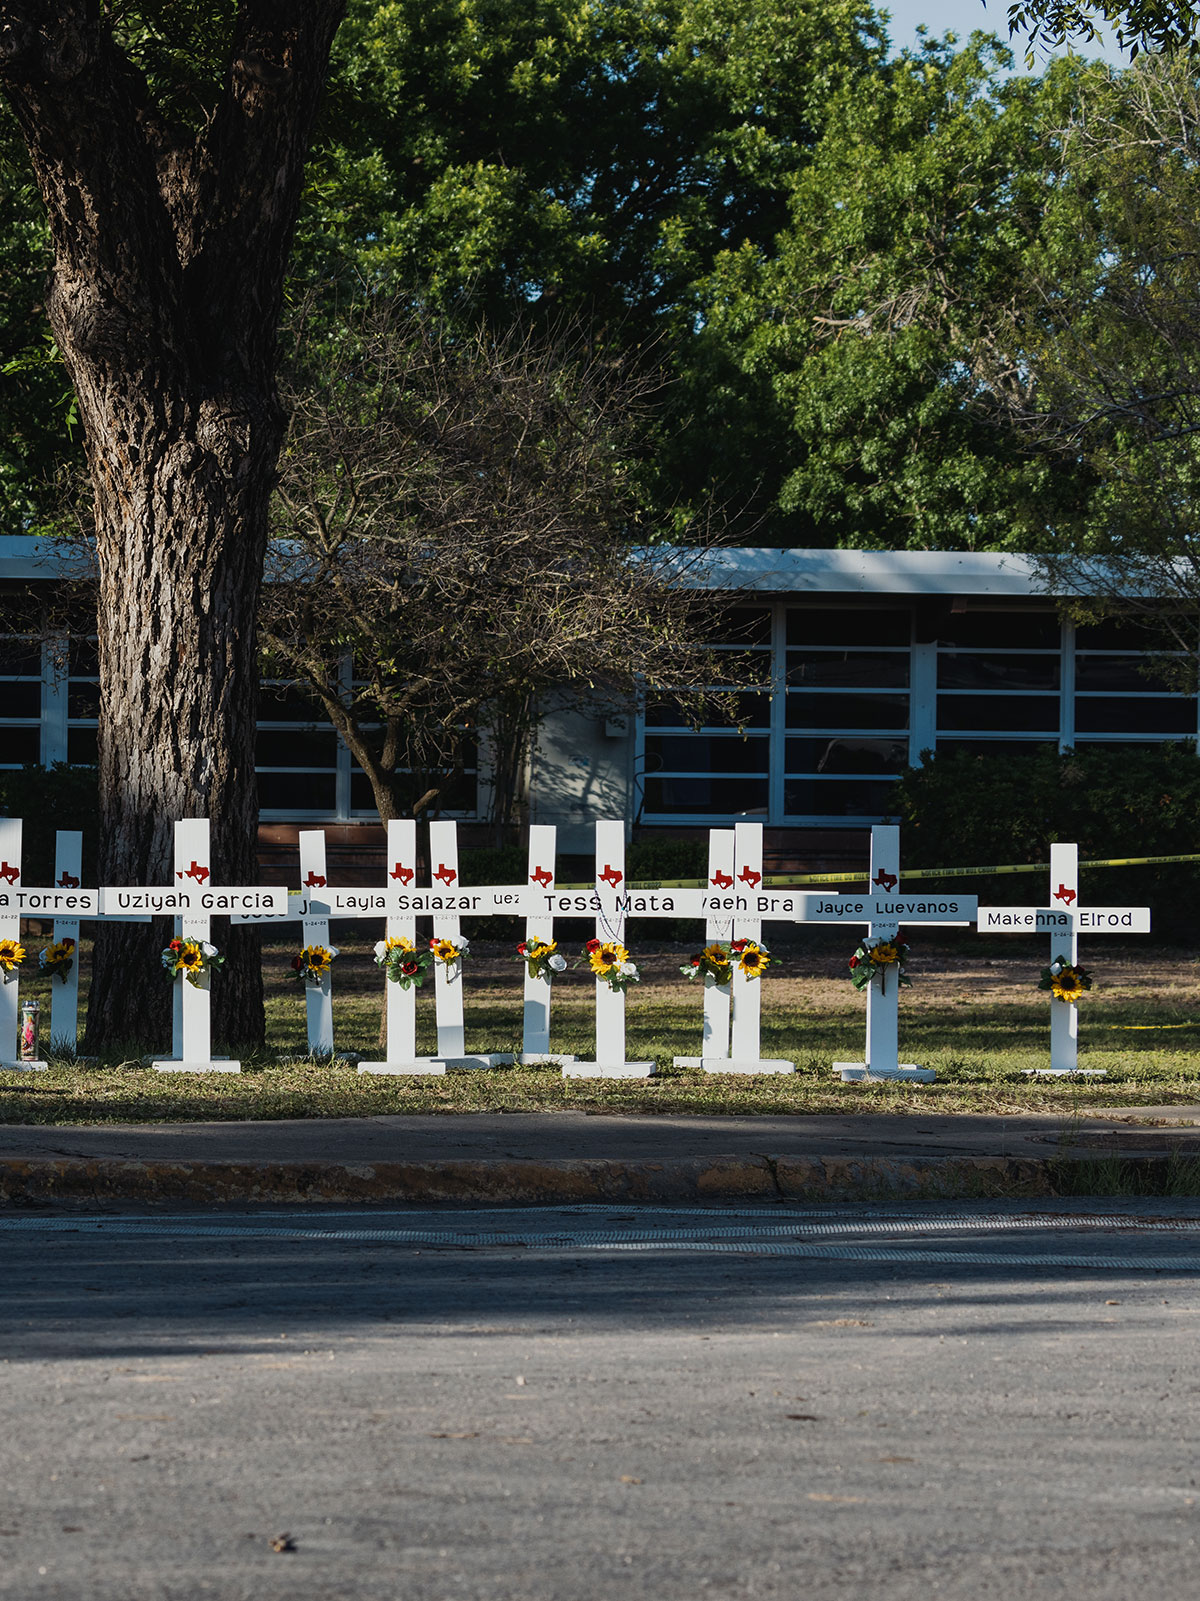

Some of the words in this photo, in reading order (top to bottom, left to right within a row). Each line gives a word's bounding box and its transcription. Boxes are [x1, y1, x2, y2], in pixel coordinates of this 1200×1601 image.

[16, 892, 91, 908] Torres
[118, 892, 190, 911] Uziyah
[201, 893, 274, 908] Garcia
[336, 895, 385, 910] Layla
[398, 896, 482, 910] Salazar
[544, 896, 602, 912] Tess
[615, 896, 674, 912] Mata
[816, 901, 864, 916] Jayce
[876, 902, 959, 914] Luevanos
[988, 912, 1068, 926] Makenna
[1080, 912, 1132, 926] Elrod
